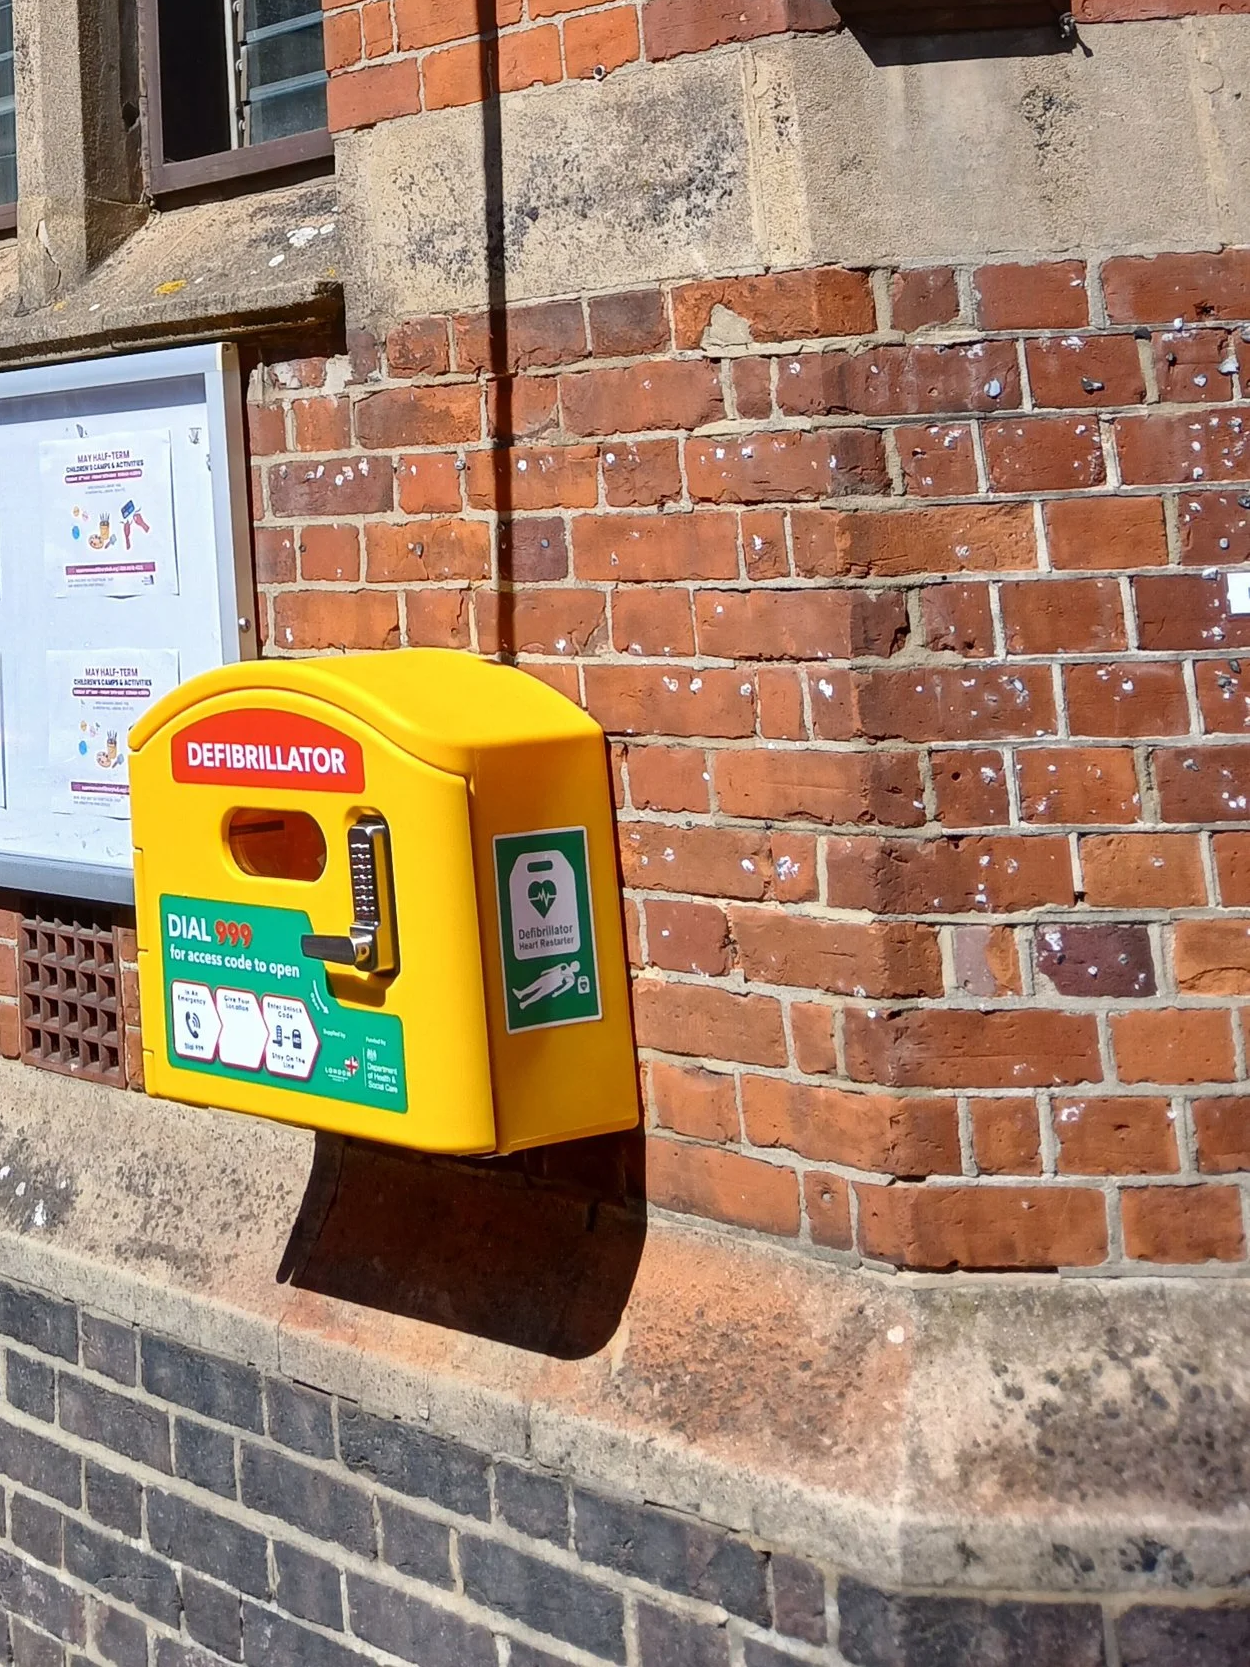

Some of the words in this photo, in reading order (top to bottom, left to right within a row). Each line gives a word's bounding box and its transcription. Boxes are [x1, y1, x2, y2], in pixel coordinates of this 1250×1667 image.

[77, 454, 92, 463] MAY
[93, 450, 130, 461] HALF-TERM
[66, 465, 93, 473] CHILDREN'S
[94, 463, 110, 471] CAMPS
[116, 459, 144, 468] ACTIVITIES
[85, 668, 100, 676] MAY
[100, 668, 138, 677] HALF-TERM
[187, 742, 346, 774] DEFIBRILLATOR
[167, 913, 212, 942] DIAL
[214, 919, 253, 948] 999
[518, 924, 573, 940] Defibrillator
[519, 941, 538, 950] Heart
[540, 936, 574, 948] Restarter
[170, 944, 187, 960] for
[188, 952, 222, 966] access
[224, 954, 253, 971] code
[254, 959, 266, 972] to
[269, 962, 300, 979] open
[177, 994, 206, 1005] Emergency
[224, 995, 235, 1003] Give
[236, 996, 250, 1005] Your
[225, 1003, 249, 1012] Location
[267, 1001, 282, 1011] Enter
[278, 1011, 293, 1020] Code
[323, 1028, 338, 1037] Supplied
[338, 1031, 346, 1039] by
[365, 1036, 380, 1045] Funded
[271, 1052, 284, 1062] Stay
[282, 1062, 295, 1070] Line
[367, 1062, 398, 1075] Department
[374, 1073, 391, 1083] Health
[368, 1081, 384, 1091] Social
[385, 1084, 398, 1093] Care
